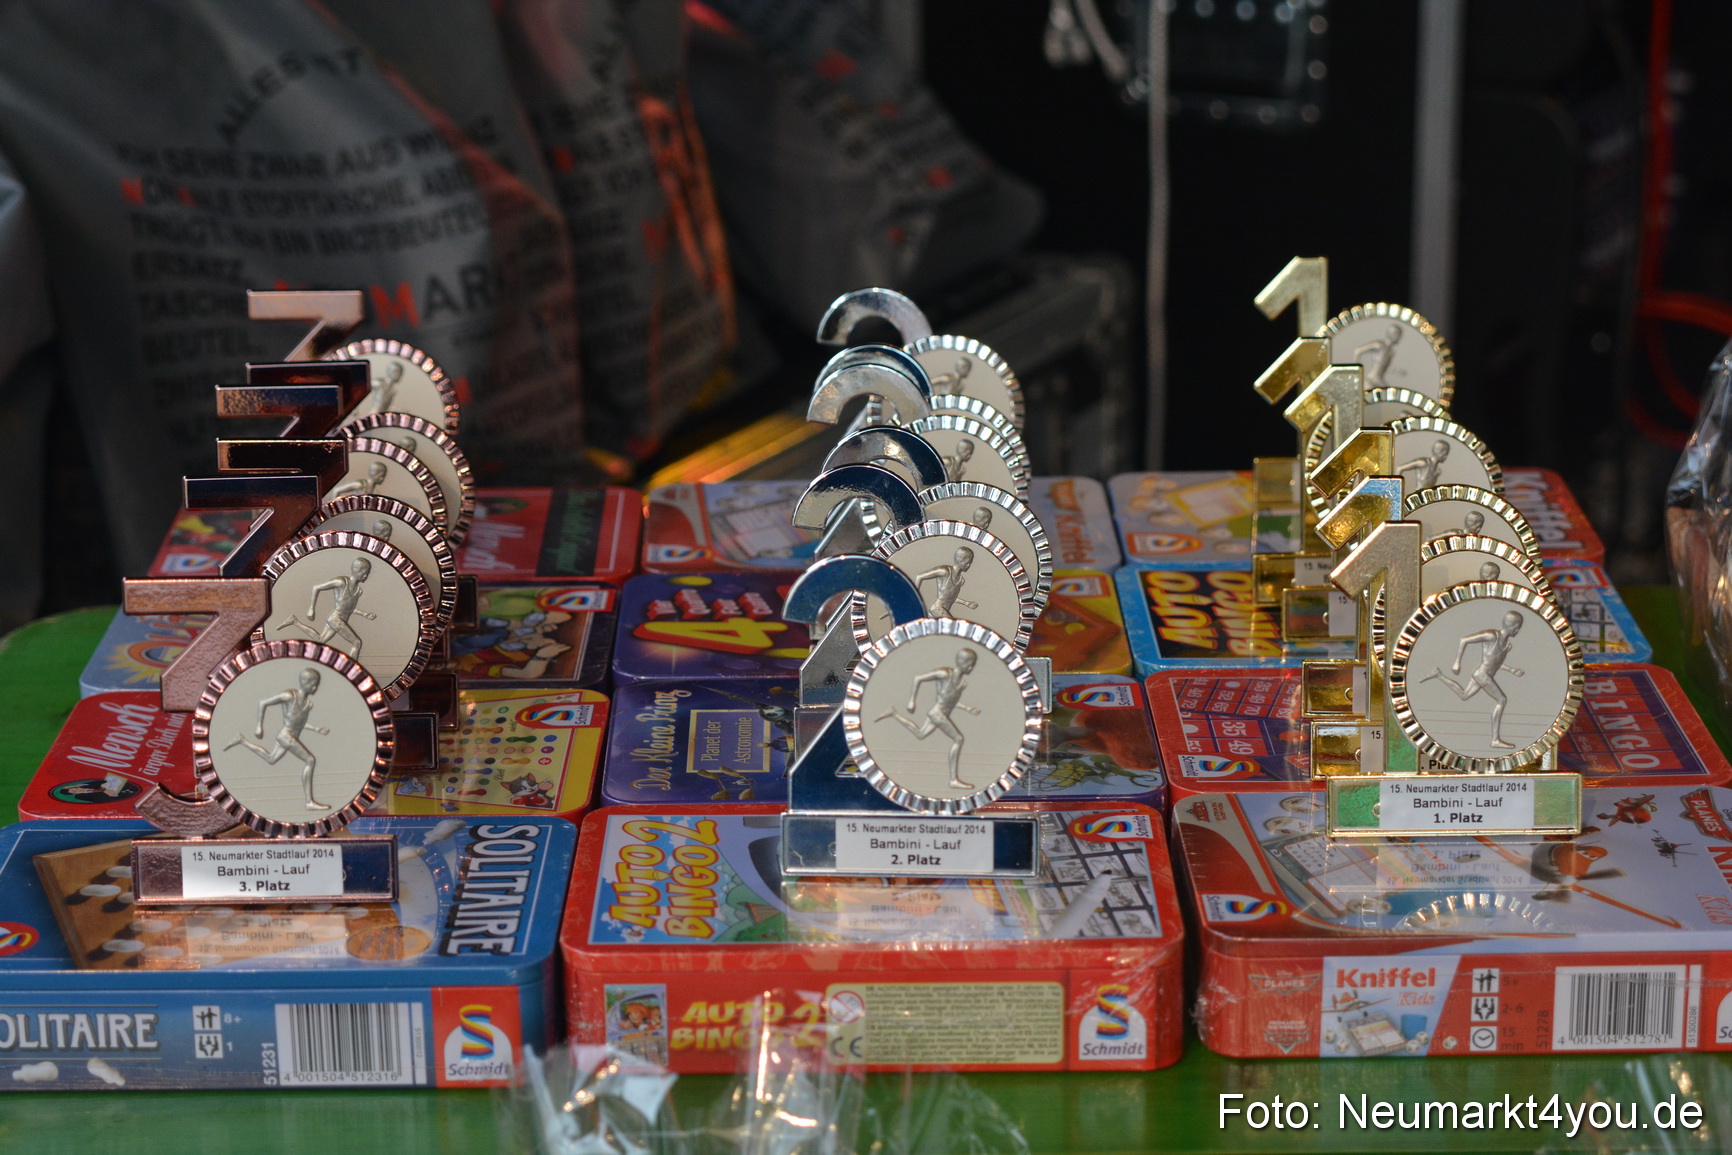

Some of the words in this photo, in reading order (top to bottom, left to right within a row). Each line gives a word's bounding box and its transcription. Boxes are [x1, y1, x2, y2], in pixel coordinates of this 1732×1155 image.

[1146, 571, 1219, 649] AUTO
[1206, 571, 1283, 658] BINGO
[703, 719, 722, 734] der
[1222, 721, 1248, 736] 35
[1584, 679, 1660, 768] BINGO
[629, 721, 680, 762] Kleine
[701, 733, 721, 762] Planet
[733, 716, 753, 765] Astronomie
[1229, 740, 1254, 755] 49
[1390, 785, 1403, 794] 15.
[1406, 784, 1459, 793] Neumarkter
[1461, 783, 1504, 793] Stadtlauf
[1506, 783, 1527, 792] 2014
[1413, 798, 1464, 809] Bambini
[1475, 797, 1503, 808] Lauf
[1434, 813, 1446, 823] 1.
[1450, 813, 1483, 823] Platz
[1690, 799, 1722, 833] PLANES
[622, 819, 721, 846] 2
[847, 823, 860, 833] 15.
[863, 824, 916, 834] Neumarkter
[919, 824, 962, 834] Stadtlauf
[964, 825, 986, 834] 2014
[870, 839, 921, 849] Bambini
[933, 839, 962, 850] Lauf
[192, 852, 206, 861] 15.
[209, 851, 264, 861] Neumarkter
[266, 849, 310, 860] Stadtlauf
[312, 848, 334, 859] 2014
[891, 854, 903, 865] 2.
[907, 854, 941, 866] Platz
[217, 865, 270, 877] Bambini
[282, 864, 310, 875] Lauf
[239, 882, 252, 892] 3.
[256, 880, 291, 892] Platz
[445, 824, 541, 955] SOLITAIRE
[608, 843, 666, 929] AUTO
[664, 845, 720, 939] BINGO
[1264, 979, 1305, 988] PLANES
[1336, 967, 1437, 989] Kniffel
[223, 1013, 242, 1024] 8+
[682, 1000, 786, 1026] AUTO
[0, 1013, 160, 1050] OLITAIRE
[1536, 1010, 1549, 1049] 51278
[1082, 1042, 1145, 1056] Schmidt
[262, 1041, 278, 1086] 51231
[298, 1072, 345, 1082] 001504
[351, 1072, 399, 1082] 512316
